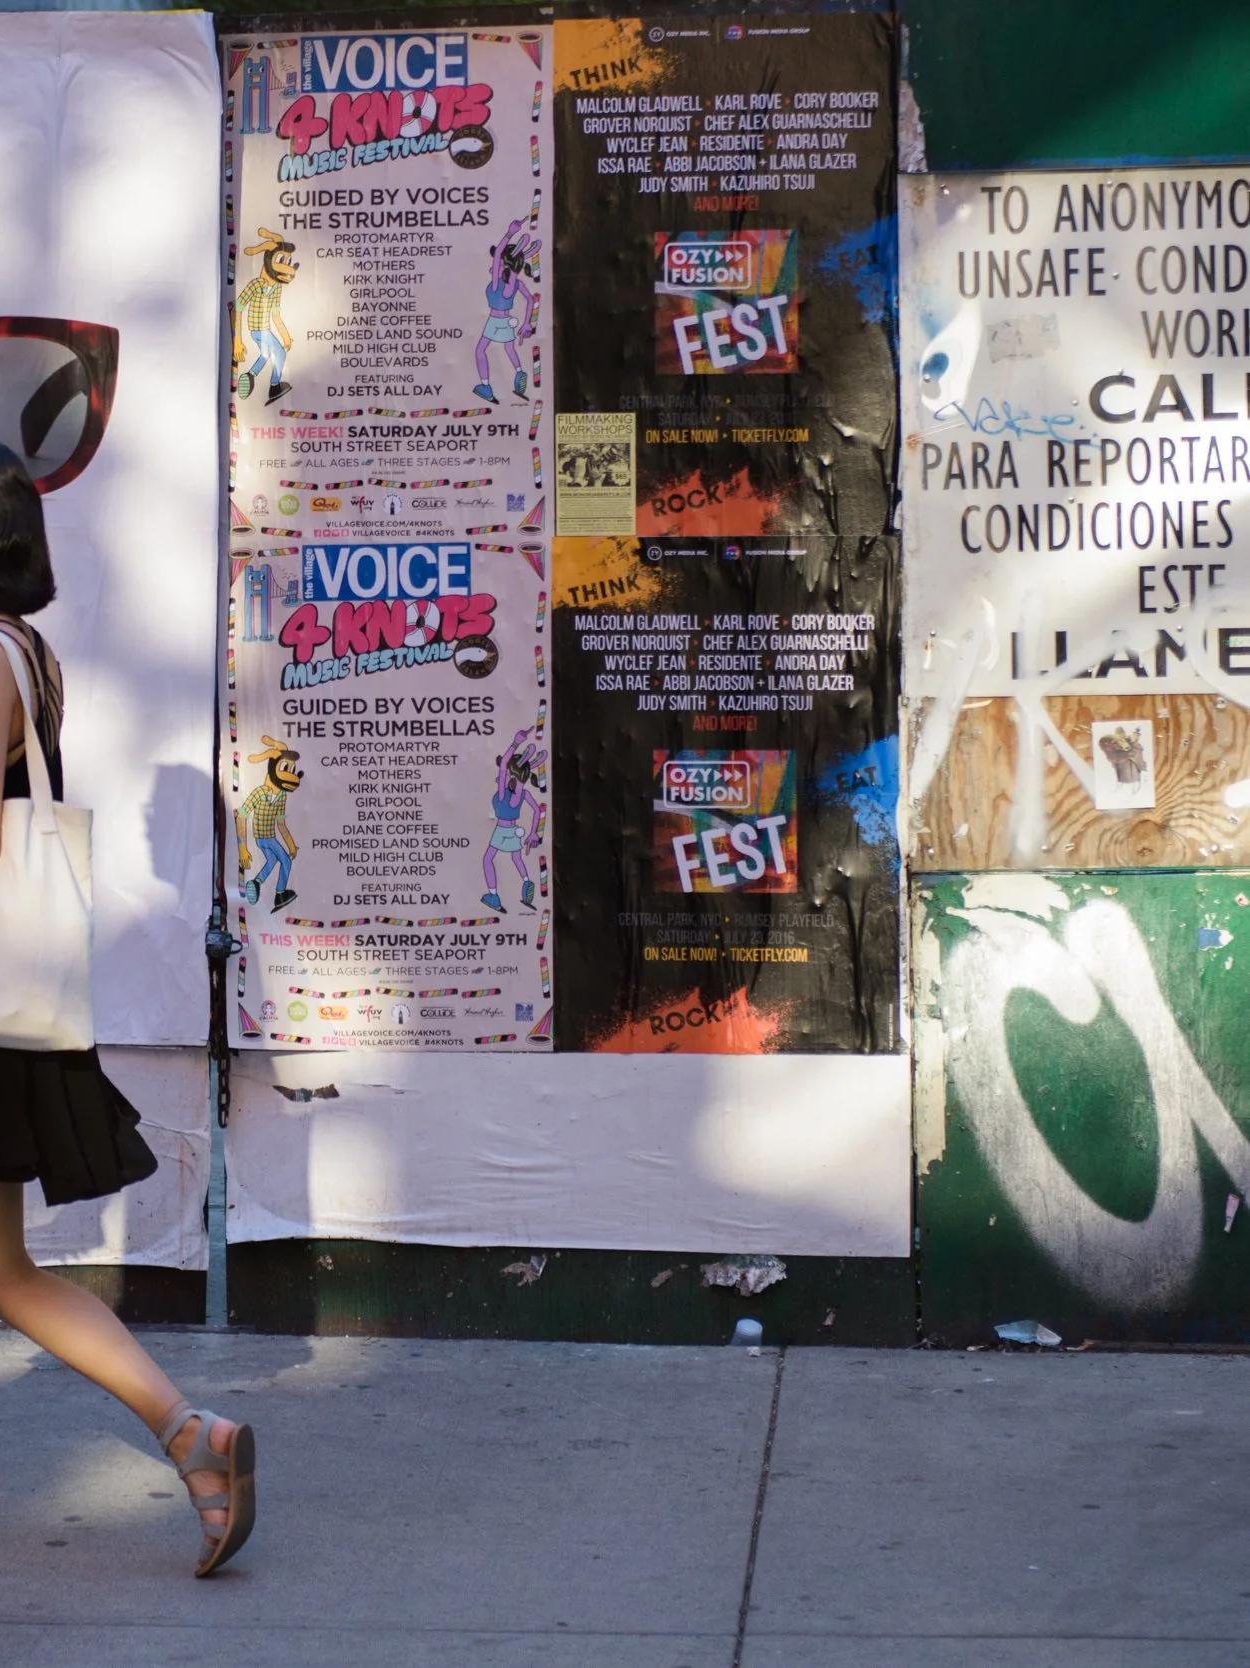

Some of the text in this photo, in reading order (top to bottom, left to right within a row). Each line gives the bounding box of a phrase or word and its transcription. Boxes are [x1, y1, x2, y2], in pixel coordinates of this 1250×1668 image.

[304, 41, 312, 91] the village
[313, 36, 464, 90] VOICE
[569, 56, 643, 88] THINK
[277, 83, 493, 155] 4 KNOTS
[278, 134, 450, 182] MUSIC FESTIVAL
[279, 187, 489, 207] GUIDED BY VOICES
[981, 179, 1250, 234] TO ANONYMO
[279, 211, 489, 229] THE STRUMBELLAS
[334, 233, 434, 244] PROTOMARTYR
[316, 246, 452, 258] CAR SEAT HEADREST
[671, 250, 713, 265] OZY
[352, 261, 415, 271] MOTHERS
[958, 244, 1248, 299] UNSAFE COND
[344, 274, 425, 285] KIRK KNIGHT
[671, 268, 744, 284] FUSION
[350, 288, 415, 298] GIRLPOOL
[352, 302, 416, 312] BAYONNE
[337, 315, 431, 326] DIANE COFFEE
[307, 328, 462, 340] PROMISED LAND SOUND
[673, 295, 788, 375] FEST
[333, 343, 436, 354] MILD HIGH CLUB
[341, 357, 428, 368] BOULEVARDS
[355, 375, 414, 383] FEATURING
[327, 385, 442, 397] DJ SETS ALL DAY
[1089, 373, 1250, 423] CAL
[558, 415, 632, 424] FILMMAKING
[251, 424, 519, 440] THIS WEEK! SATURDAY JULY 9TH
[558, 425, 633, 434] WORKSHOPS
[291, 440, 478, 453] SOUTH STREET SEAPORT
[260, 457, 510, 469] FREE ALL AGES THREE STAGES 1-8PM
[922, 436, 1250, 491] PARA REPORTAR
[652, 485, 723, 516] ROCK
[961, 500, 1233, 554] CONDICIONES
[314, 546, 467, 598] VOICE
[568, 576, 642, 605] THINK
[279, 594, 497, 663] 4 KNOTS
[575, 615, 875, 631] MALCOLM GLADWELL KARL ROVE CORY BOOKER
[582, 635, 868, 651] GROVER NORQUIST CHEF ALEX GUARNASCHELLI
[281, 642, 454, 691] MUSIC FESTIVAL
[605, 656, 845, 671] WYCLEF JEAN RESIDENTE ANDRA DAY
[596, 676, 854, 691] ISSA RAE ABBI JACOBSON ILANA GLAZER
[637, 696, 812, 711] JUDY SMITH KAZUHIRO TSUJI
[693, 716, 757, 731] AND MORE!
[670, 768, 712, 783] OZY
[670, 786, 743, 801] FUSION
[673, 815, 786, 893] FEST
[619, 913, 664, 926] CENTRAL
[701, 913, 722, 926] NYC
[779, 913, 834, 927] PLAYFIELD
[657, 931, 710, 944] SATURDAY
[769, 930, 795, 944] 2016
[644, 948, 808, 962] ON SALE NOW! TICKETFLY.COM
[650, 1004, 722, 1035] ROCK
